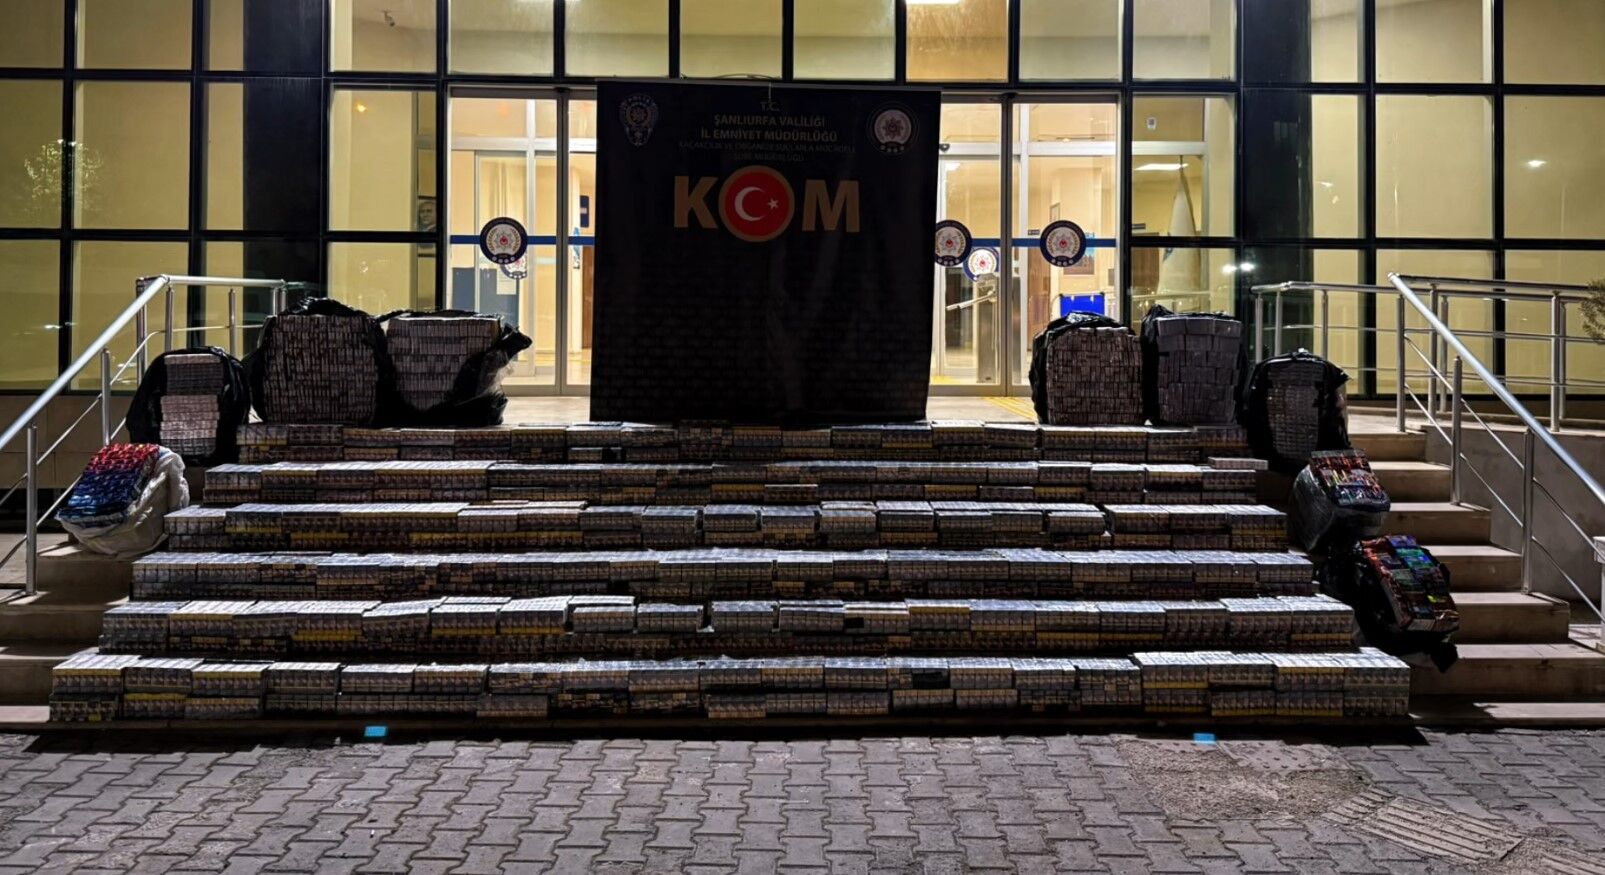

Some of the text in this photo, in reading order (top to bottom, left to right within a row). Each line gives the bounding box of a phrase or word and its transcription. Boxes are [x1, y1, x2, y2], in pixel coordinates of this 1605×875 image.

[714, 114, 777, 127] ŞANLIURFA
[713, 129, 761, 141] EMNİYET
[764, 130, 838, 142] MÜDÜRLÜĞÜ
[674, 165, 860, 242] KOM
